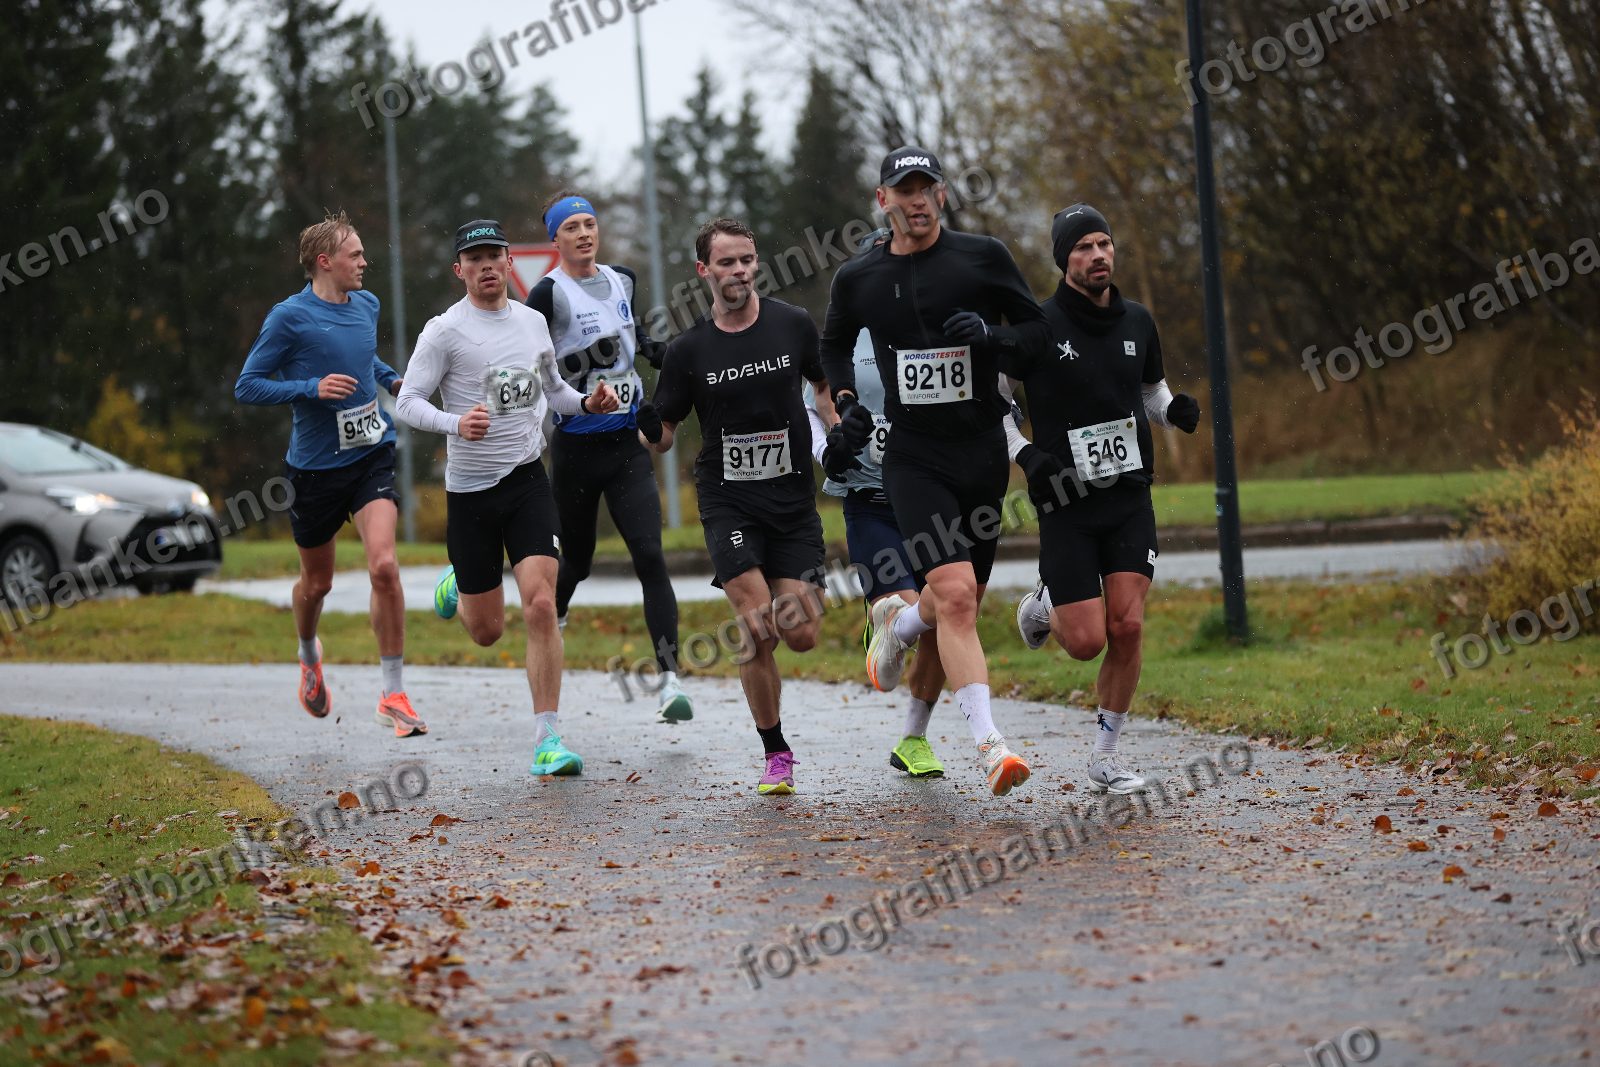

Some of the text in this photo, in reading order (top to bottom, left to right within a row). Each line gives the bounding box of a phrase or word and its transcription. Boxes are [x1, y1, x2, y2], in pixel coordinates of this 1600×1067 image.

[895, 156, 931, 170] HOKA
[466, 227, 497, 241] HOKA
[903, 349, 966, 361] NORGESTESTEN
[904, 361, 966, 391] 9218
[501, 380, 533, 405] 614
[344, 411, 381, 440] 9478
[729, 432, 786, 444] NORGESTESTEN
[729, 441, 785, 469] 9177
[1087, 435, 1127, 467] 546
